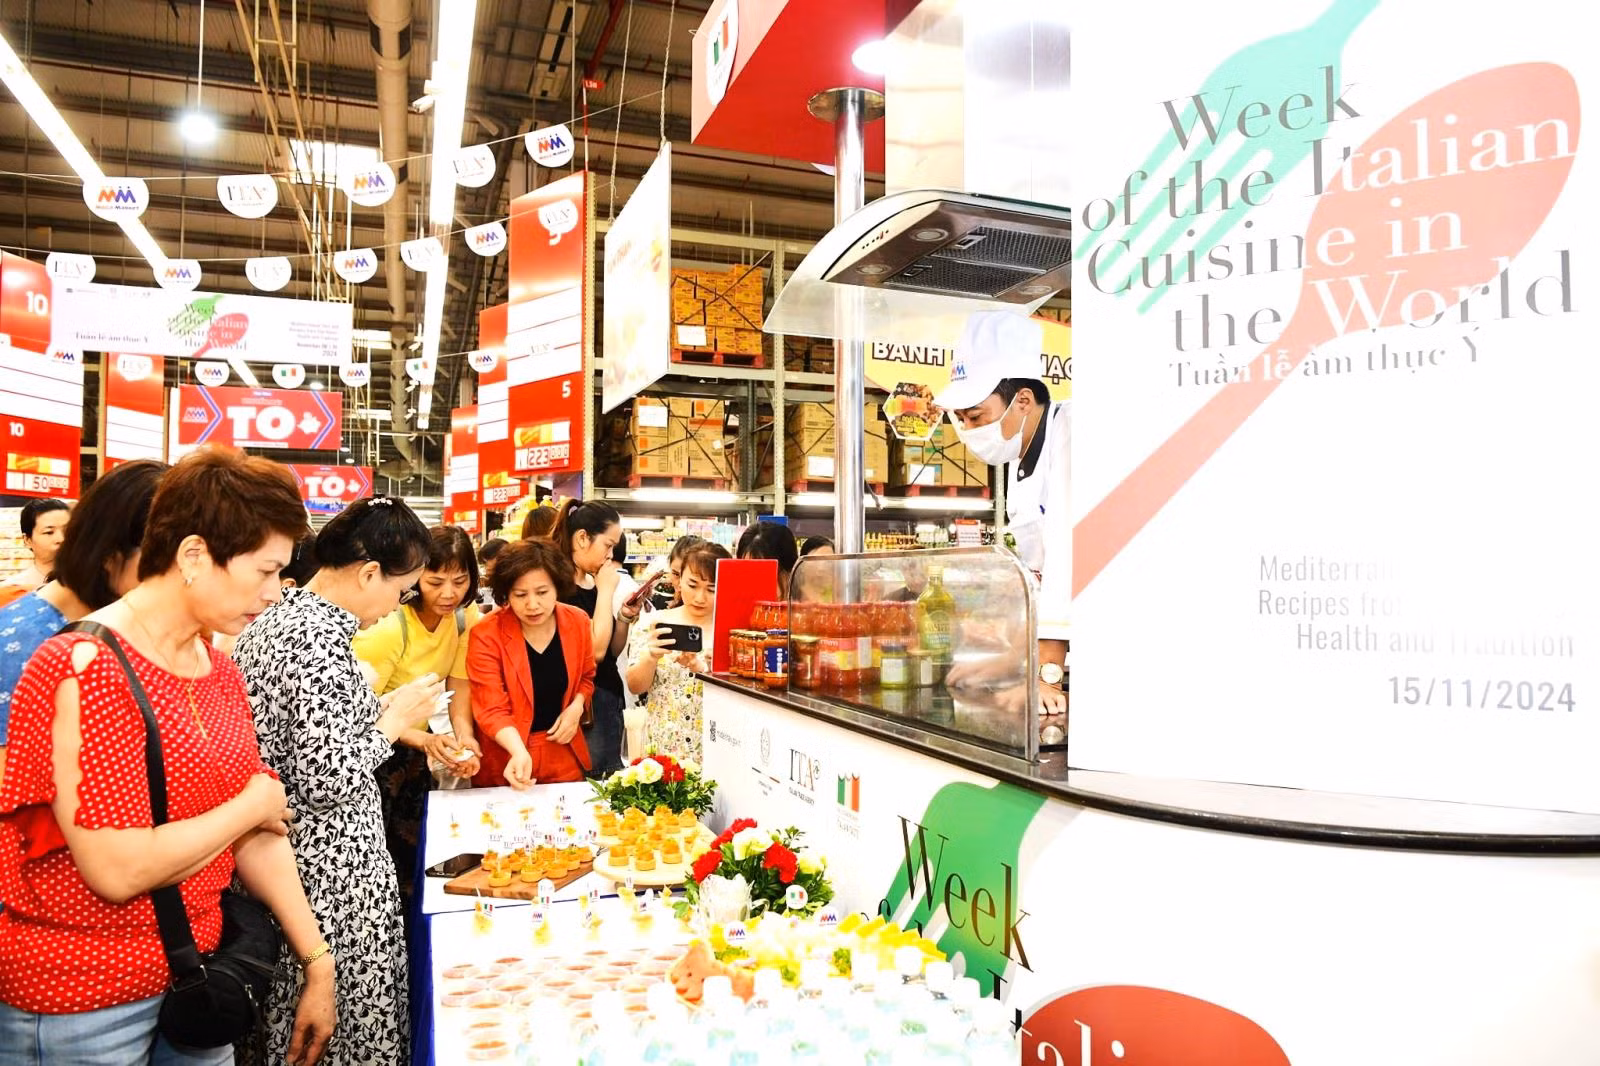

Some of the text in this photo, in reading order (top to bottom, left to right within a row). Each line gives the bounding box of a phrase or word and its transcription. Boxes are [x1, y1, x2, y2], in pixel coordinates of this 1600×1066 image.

[1160, 64, 1362, 152] Week
[1082, 113, 1578, 233] of the Italian
[1087, 196, 1468, 296] Cuisine in
[26, 290, 49, 317] 10
[1174, 248, 1578, 352] the World
[562, 380, 572, 399] 5
[9, 421, 25, 437] 10
[1259, 589, 1350, 621] Recipes
[1297, 623, 1378, 653] Health
[1389, 630, 1435, 655] and
[1389, 676, 1576, 713] 15/11/2024
[897, 815, 1034, 973] Week
